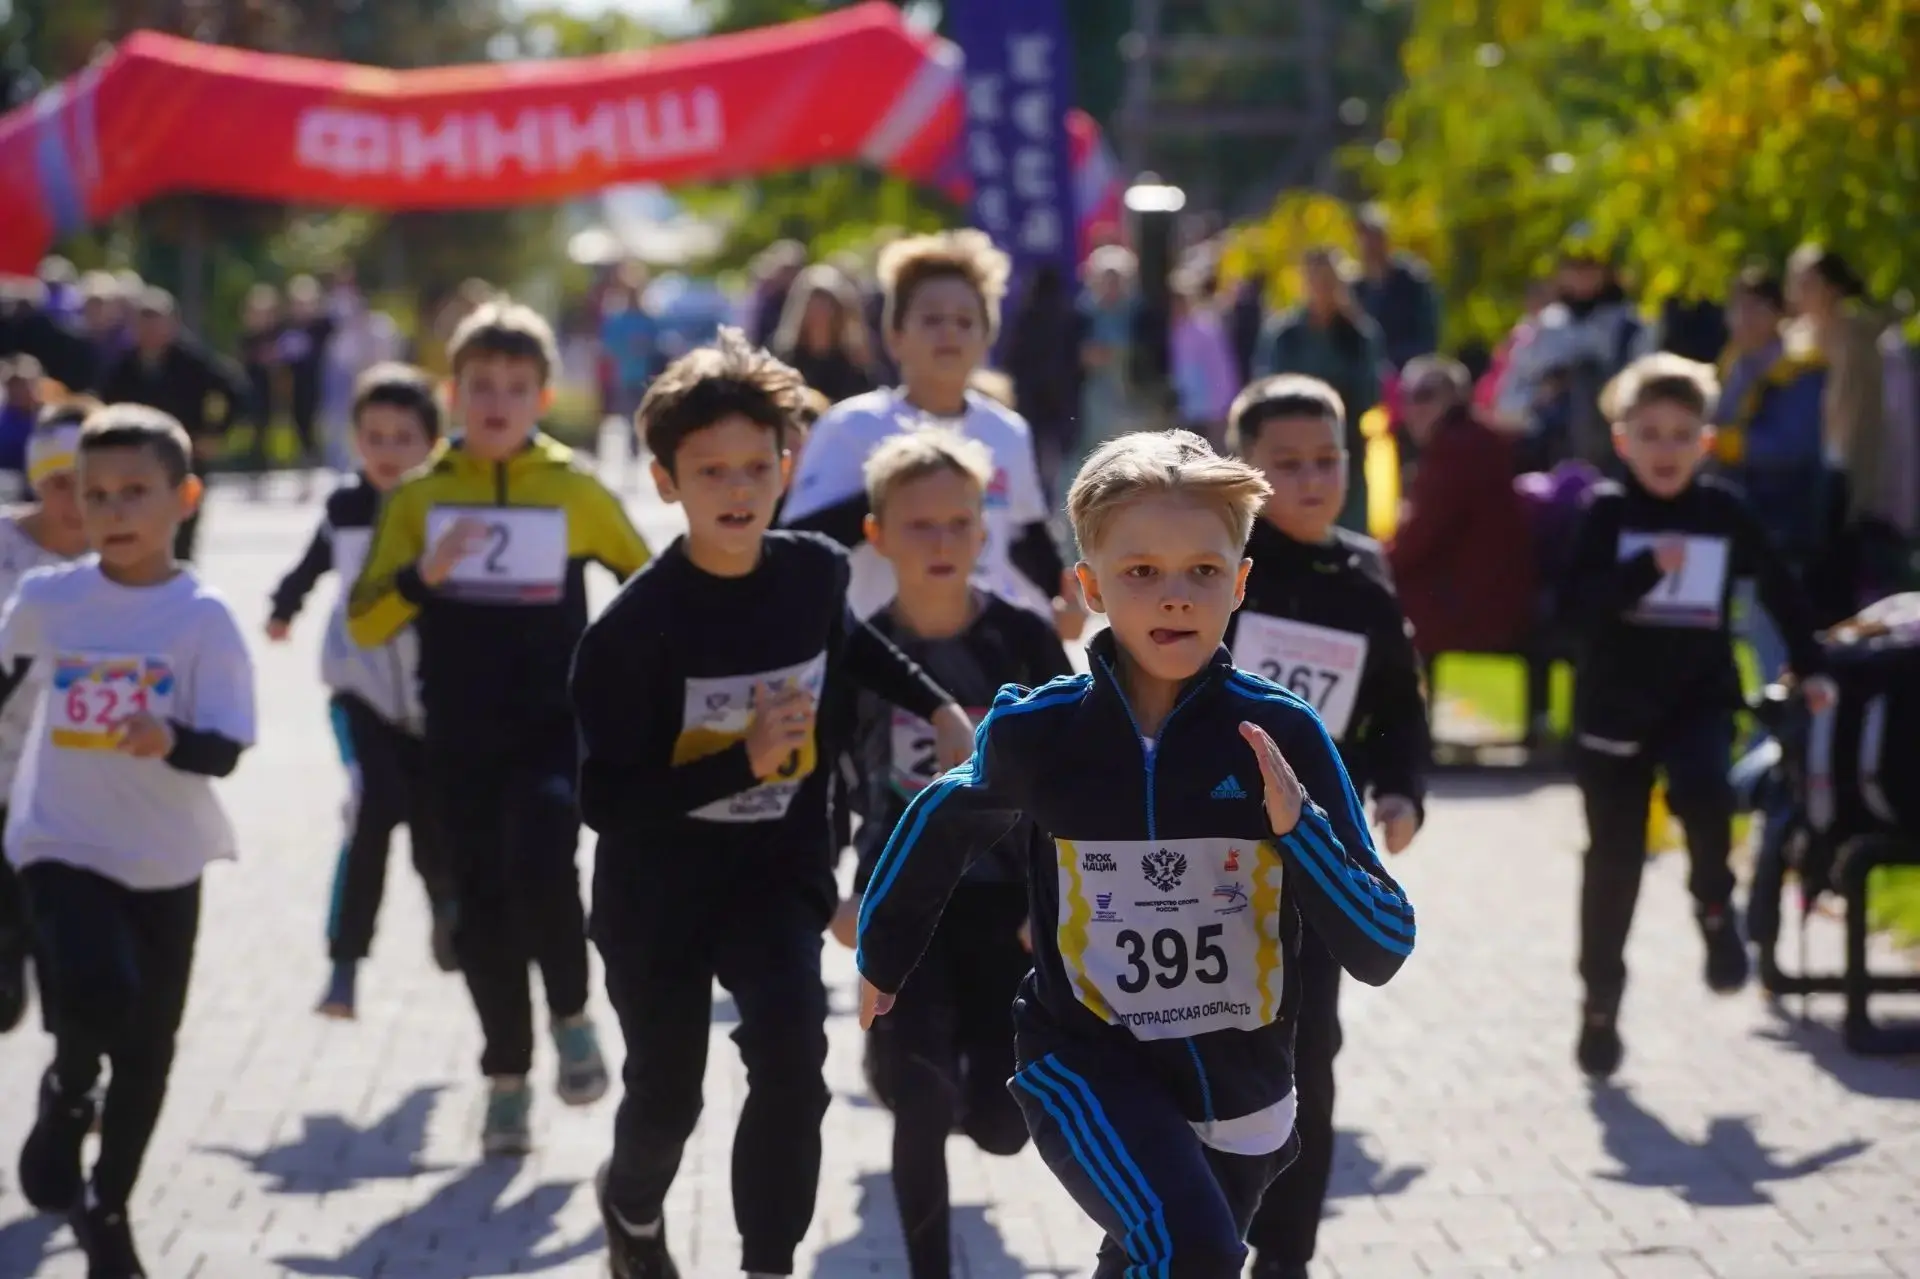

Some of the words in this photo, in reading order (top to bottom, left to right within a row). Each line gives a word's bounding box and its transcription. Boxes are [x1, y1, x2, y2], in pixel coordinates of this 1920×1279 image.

[296, 87, 724, 178] ФИНИШ
[485, 521, 512, 575] 2
[1082, 861, 1117, 873] НАЦИИ
[1085, 853, 1112, 862] КРОСС
[1116, 923, 1228, 993] 395
[1202, 1001, 1251, 1017] ОБЛАСТЬ
